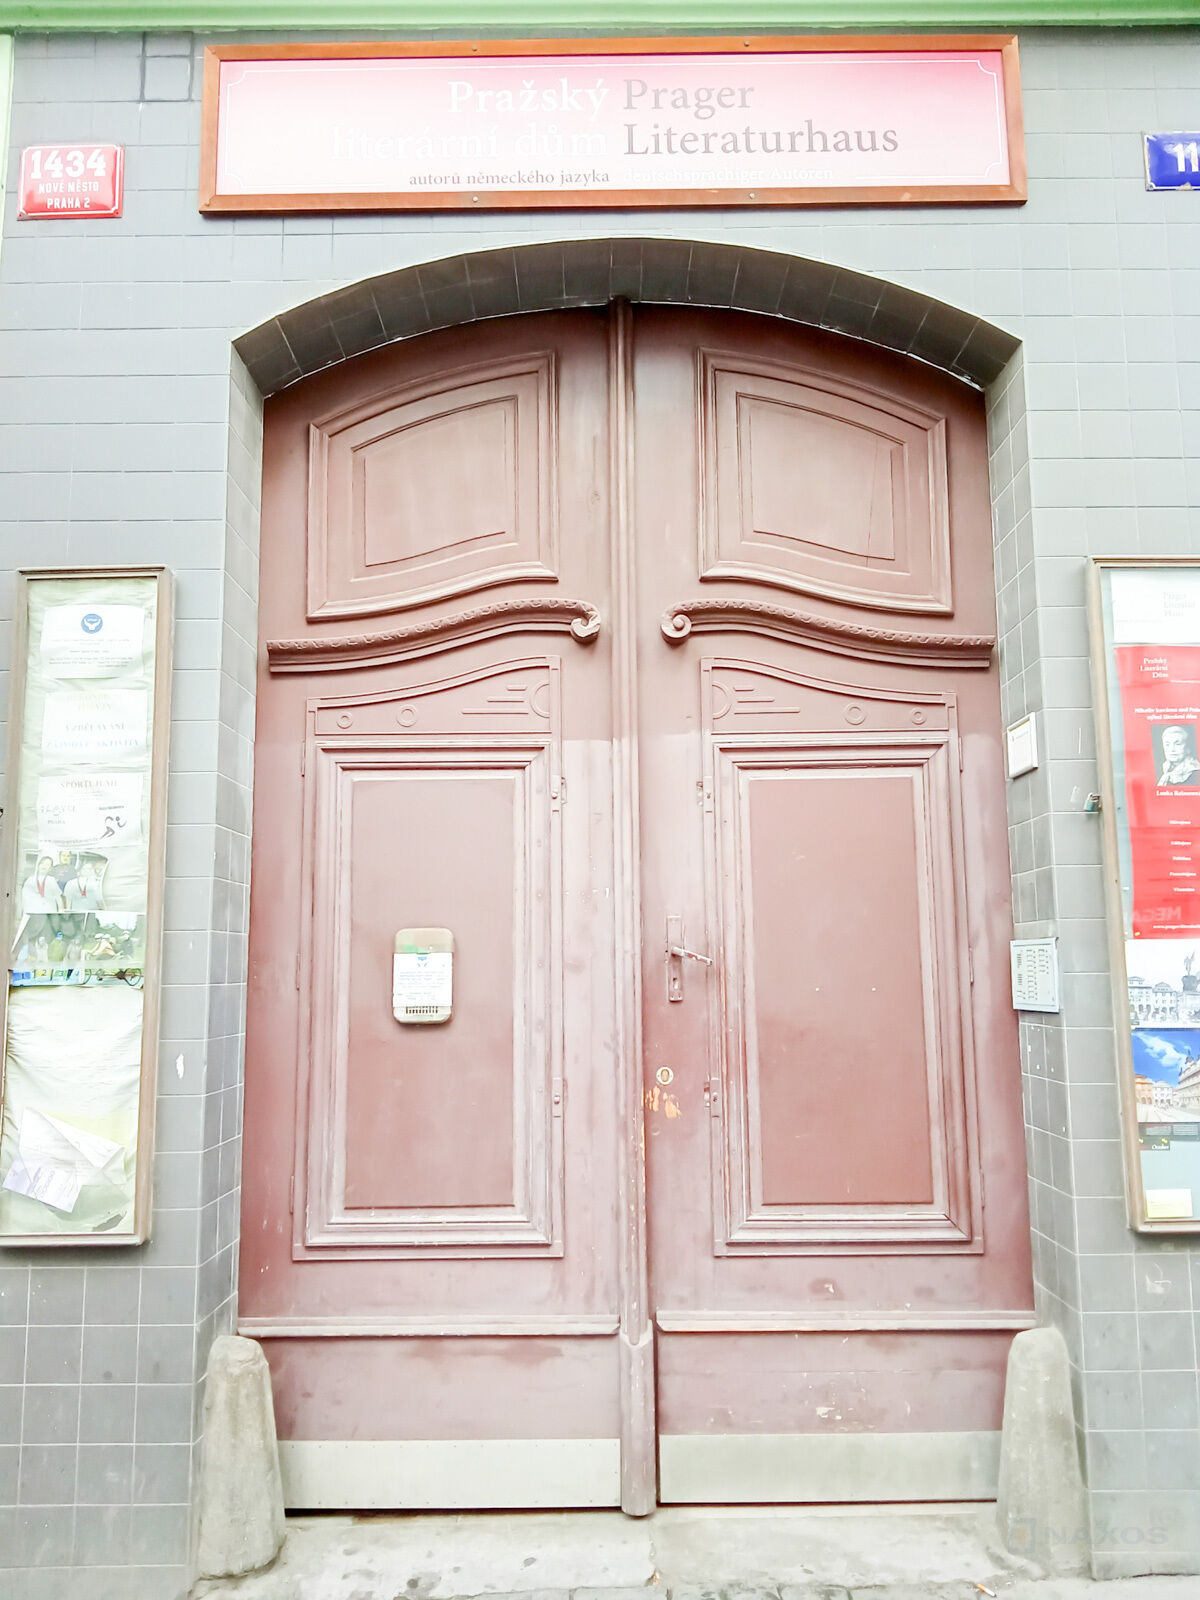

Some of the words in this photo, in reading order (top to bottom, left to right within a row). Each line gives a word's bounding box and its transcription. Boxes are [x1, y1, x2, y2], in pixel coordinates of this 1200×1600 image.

[447, 78, 610, 122] Pražský
[623, 78, 755, 120] Prager
[330, 125, 499, 160] literární
[514, 122, 609, 158] dům
[623, 119, 899, 155] Literaturhaus
[30, 149, 106, 179] 1434
[1172, 142, 1199, 172] 11
[409, 169, 461, 185] autorů
[467, 168, 555, 185] německého
[559, 168, 610, 187] jazyka
[623, 167, 765, 184] deutschsprachiger
[771, 166, 833, 180] Autoren
[47, 197, 80, 209] PRAHA
[83, 197, 90, 208] 2
